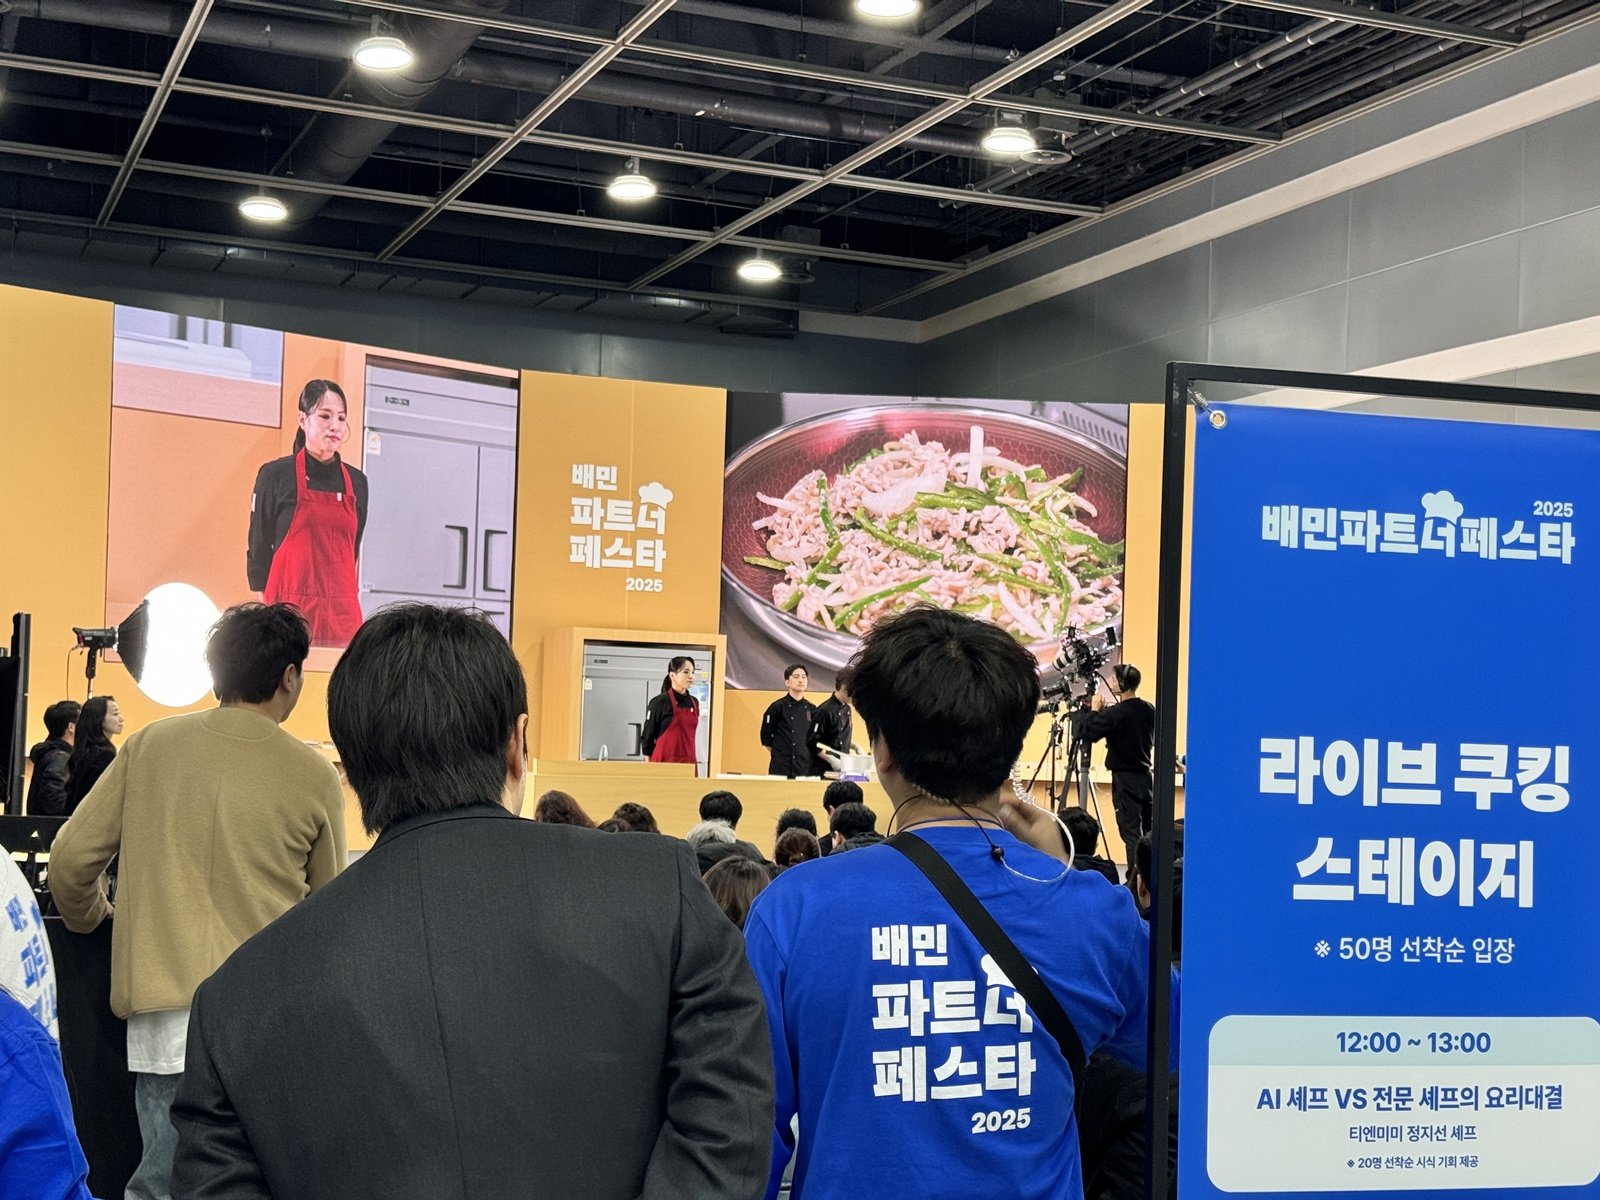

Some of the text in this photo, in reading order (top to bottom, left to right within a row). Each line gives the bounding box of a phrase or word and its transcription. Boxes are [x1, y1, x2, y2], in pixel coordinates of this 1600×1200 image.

[571, 463, 618, 491] 배민
[571, 497, 666, 534] 파트너
[1533, 500, 1574, 518] 2025
[1261, 504, 1575, 564] 배민파트너페스타
[569, 535, 666, 573] 페스타
[625, 577, 663, 593] 2025
[1260, 736, 1569, 812] 라이브 쿠킹
[1293, 838, 1533, 907] 스테이지
[871, 923, 948, 967] 배민
[1339, 935, 1392, 963] 50명
[1400, 936, 1466, 963] 선착순
[1472, 937, 1516, 964] 입장
[872, 979, 1034, 1036] 파트너
[1336, 1031, 1401, 1053] 12:00
[1427, 1032, 1491, 1054] 13:00
[873, 1042, 1036, 1102] 페스타
[1256, 1084, 1563, 1112] AI 셰프 VS 전문 셰프의 요리대결
[971, 1107, 1031, 1134] 2025
[1349, 1124, 1477, 1143] 티엔미미 정지선 셰프
[1357, 1156, 1382, 1170] 20명
[1384, 1155, 1414, 1169] 선착순
[1416, 1155, 1436, 1169] 시식
[1437, 1155, 1457, 1169] 기회
[1459, 1155, 1480, 1168] 제공
